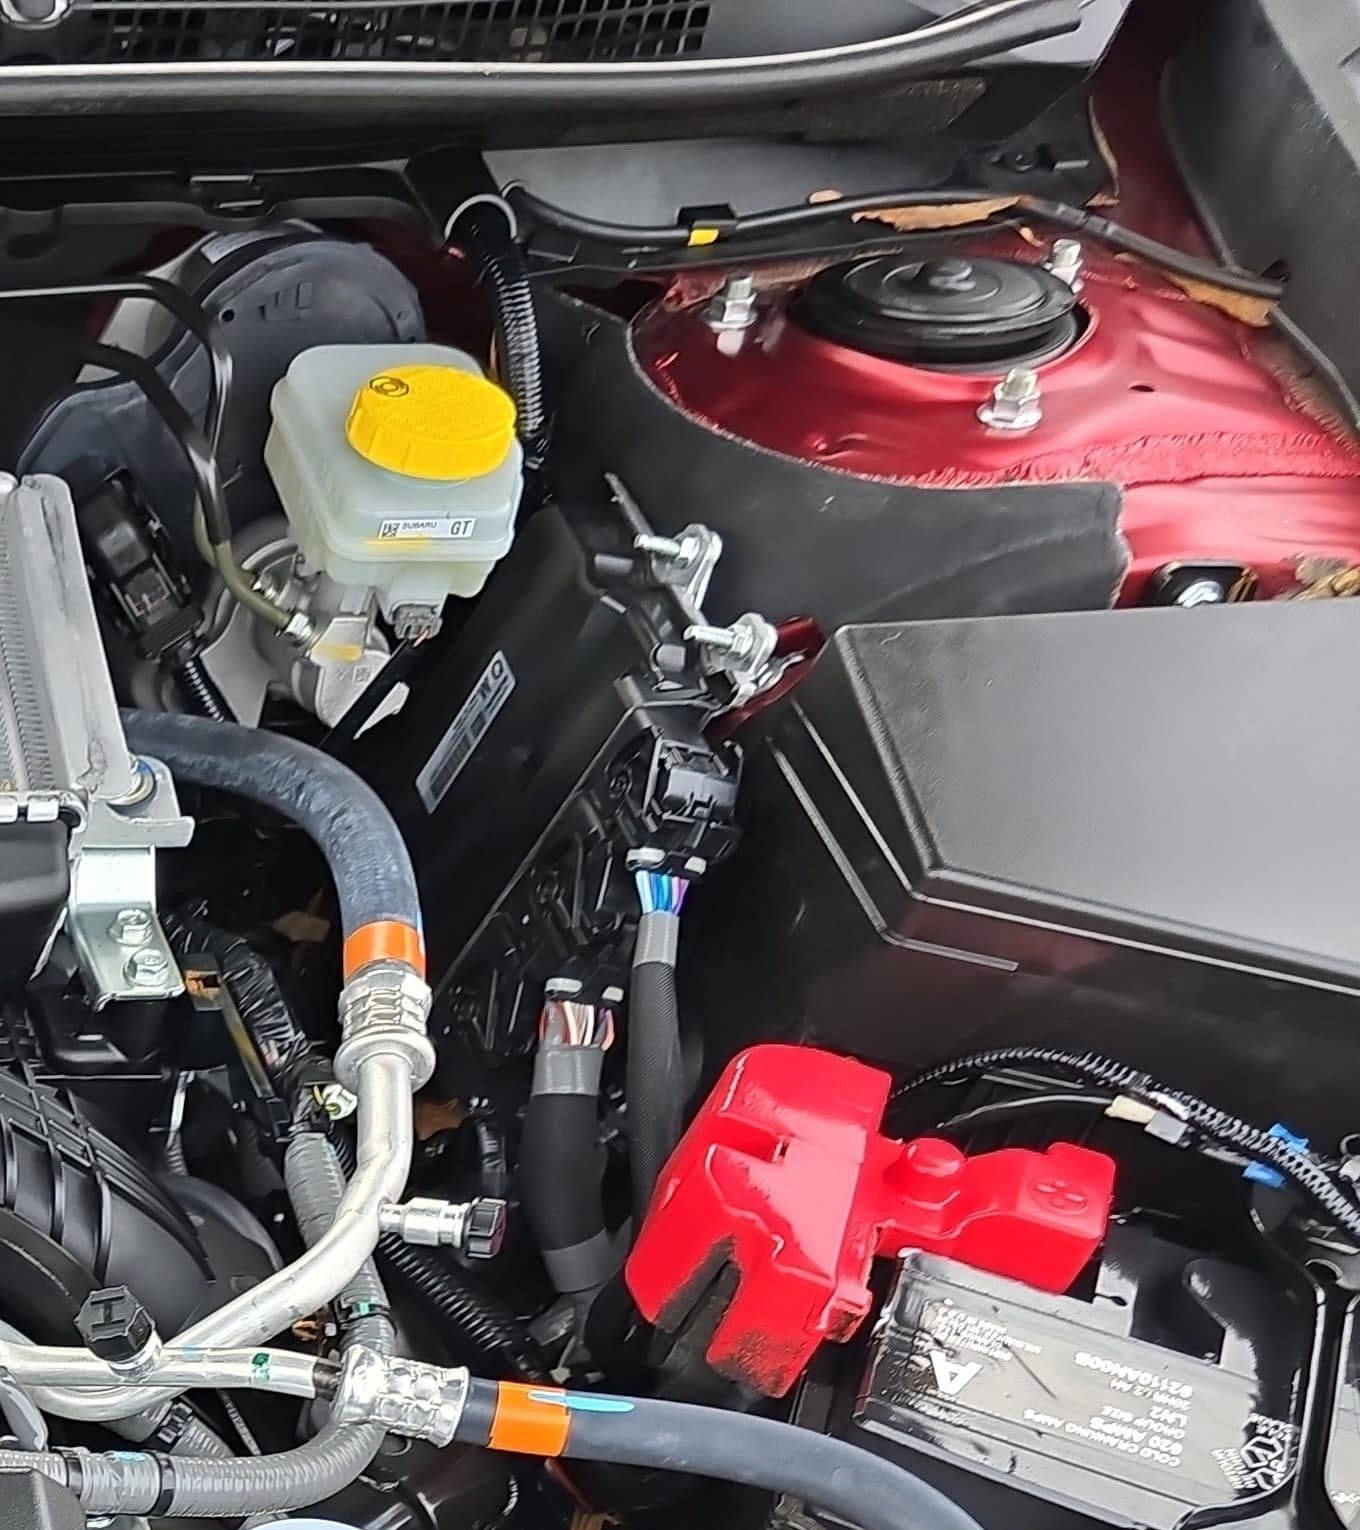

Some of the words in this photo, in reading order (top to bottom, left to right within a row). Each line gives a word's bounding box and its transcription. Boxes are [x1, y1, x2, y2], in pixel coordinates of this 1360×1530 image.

[450, 519, 473, 536] GT
[1022, 1407, 1064, 1430] AMPS
[1088, 1415, 1149, 1444] AMPS
[1136, 1415, 1186, 1440] GROUP
[1065, 1421, 1141, 1455] CRANKING
[1139, 1445, 1181, 1468] COLD
